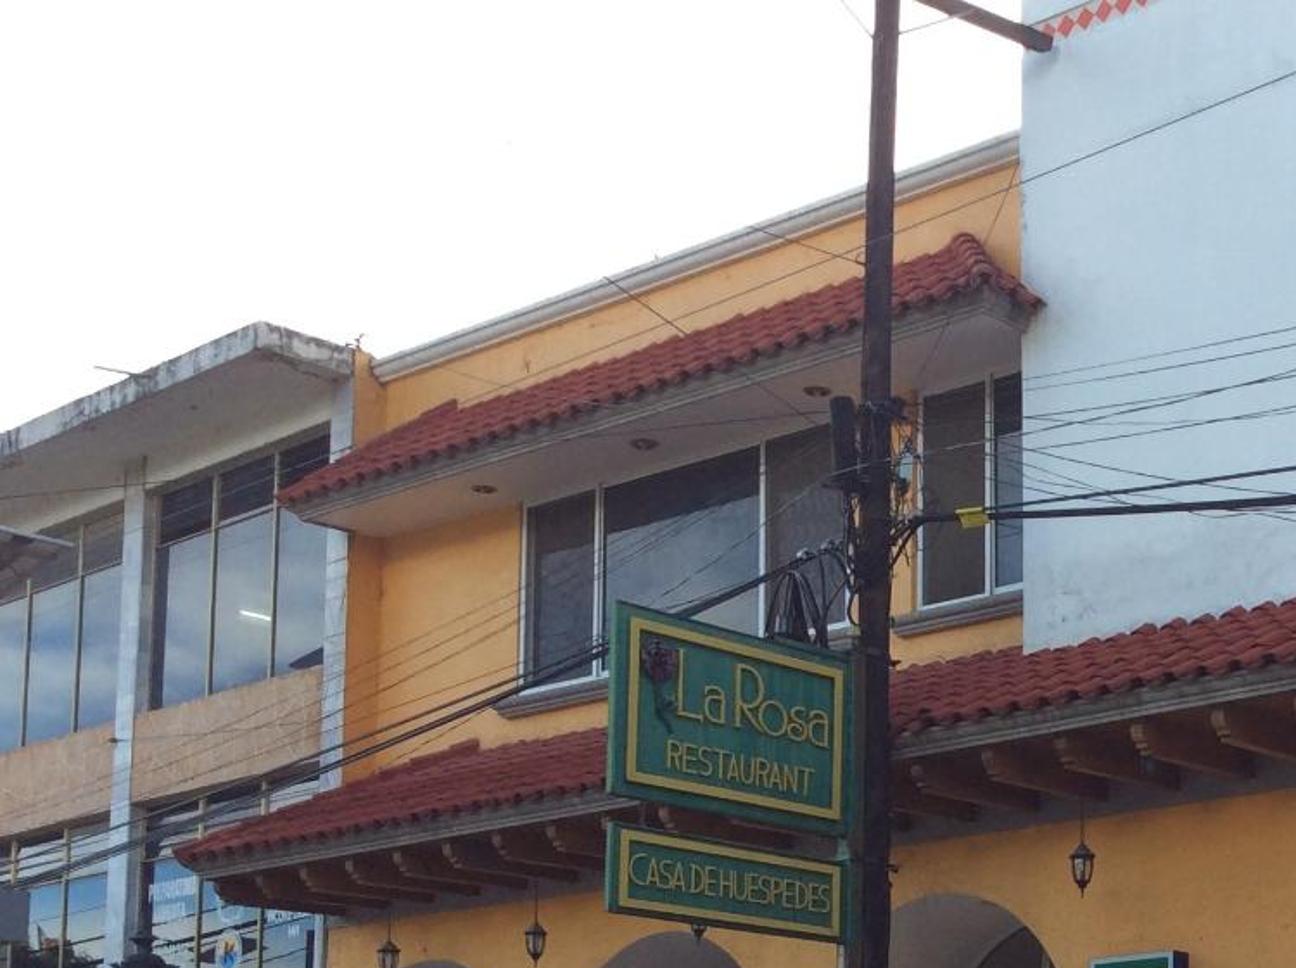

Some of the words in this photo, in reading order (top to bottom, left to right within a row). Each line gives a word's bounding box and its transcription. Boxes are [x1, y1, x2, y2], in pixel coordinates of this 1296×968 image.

[676, 648, 726, 724] La
[734, 663, 830, 748] Rosa
[666, 739, 816, 795] RESTAURANT
[629, 852, 686, 890] CASA
[690, 863, 716, 897] DE
[720, 869, 831, 913] HUESPEDES
